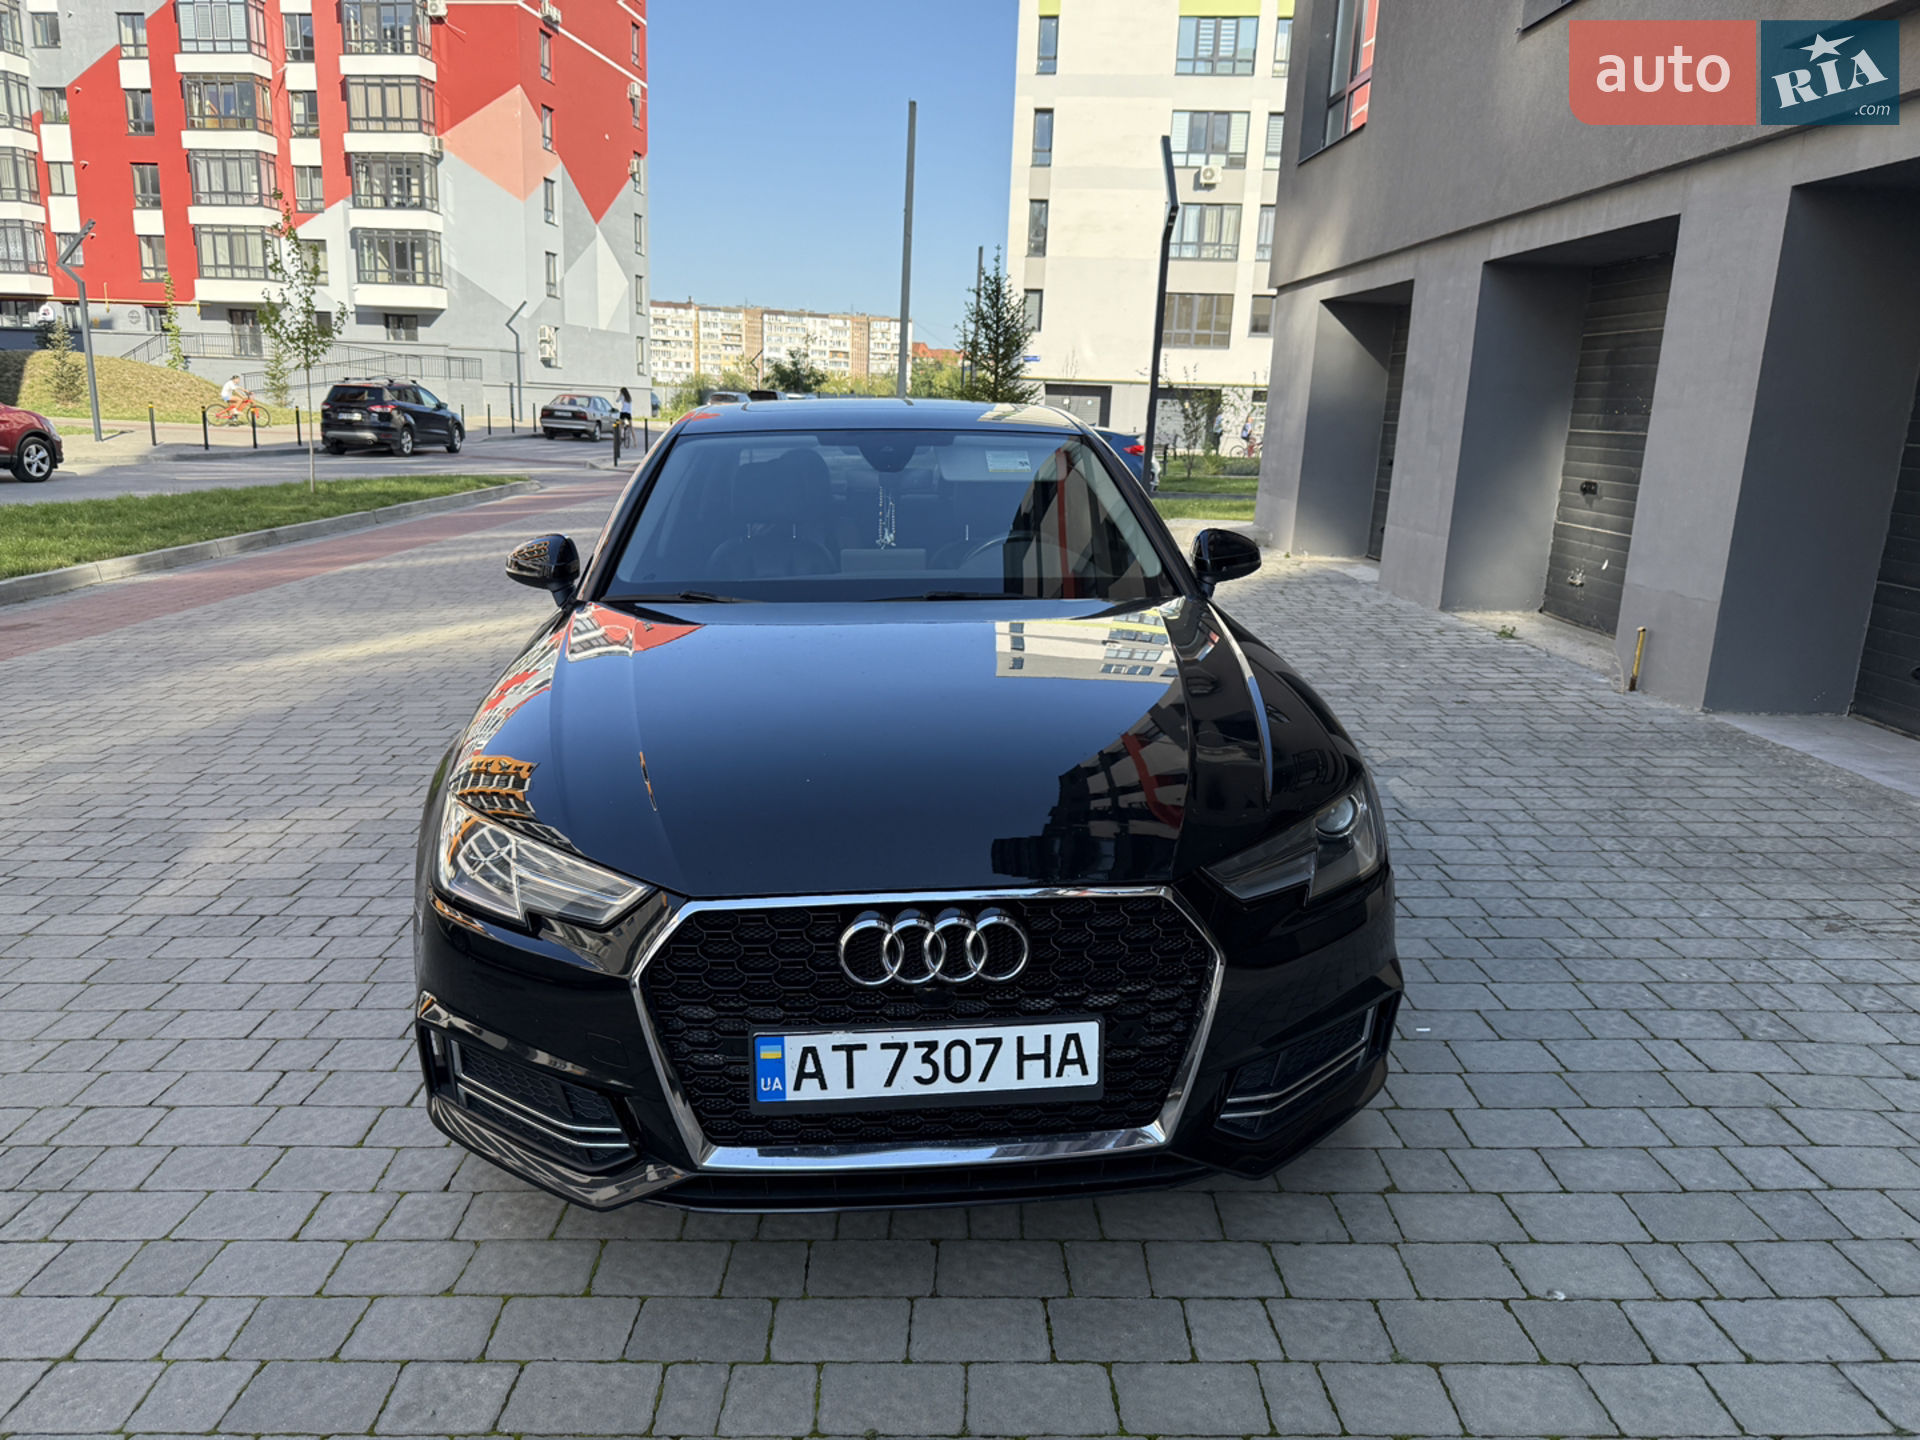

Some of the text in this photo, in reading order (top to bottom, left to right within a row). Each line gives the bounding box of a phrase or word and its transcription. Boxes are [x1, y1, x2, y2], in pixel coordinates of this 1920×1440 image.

[793, 1032, 1089, 1092] AT 7307 HA
[760, 1077, 783, 1092] UA
